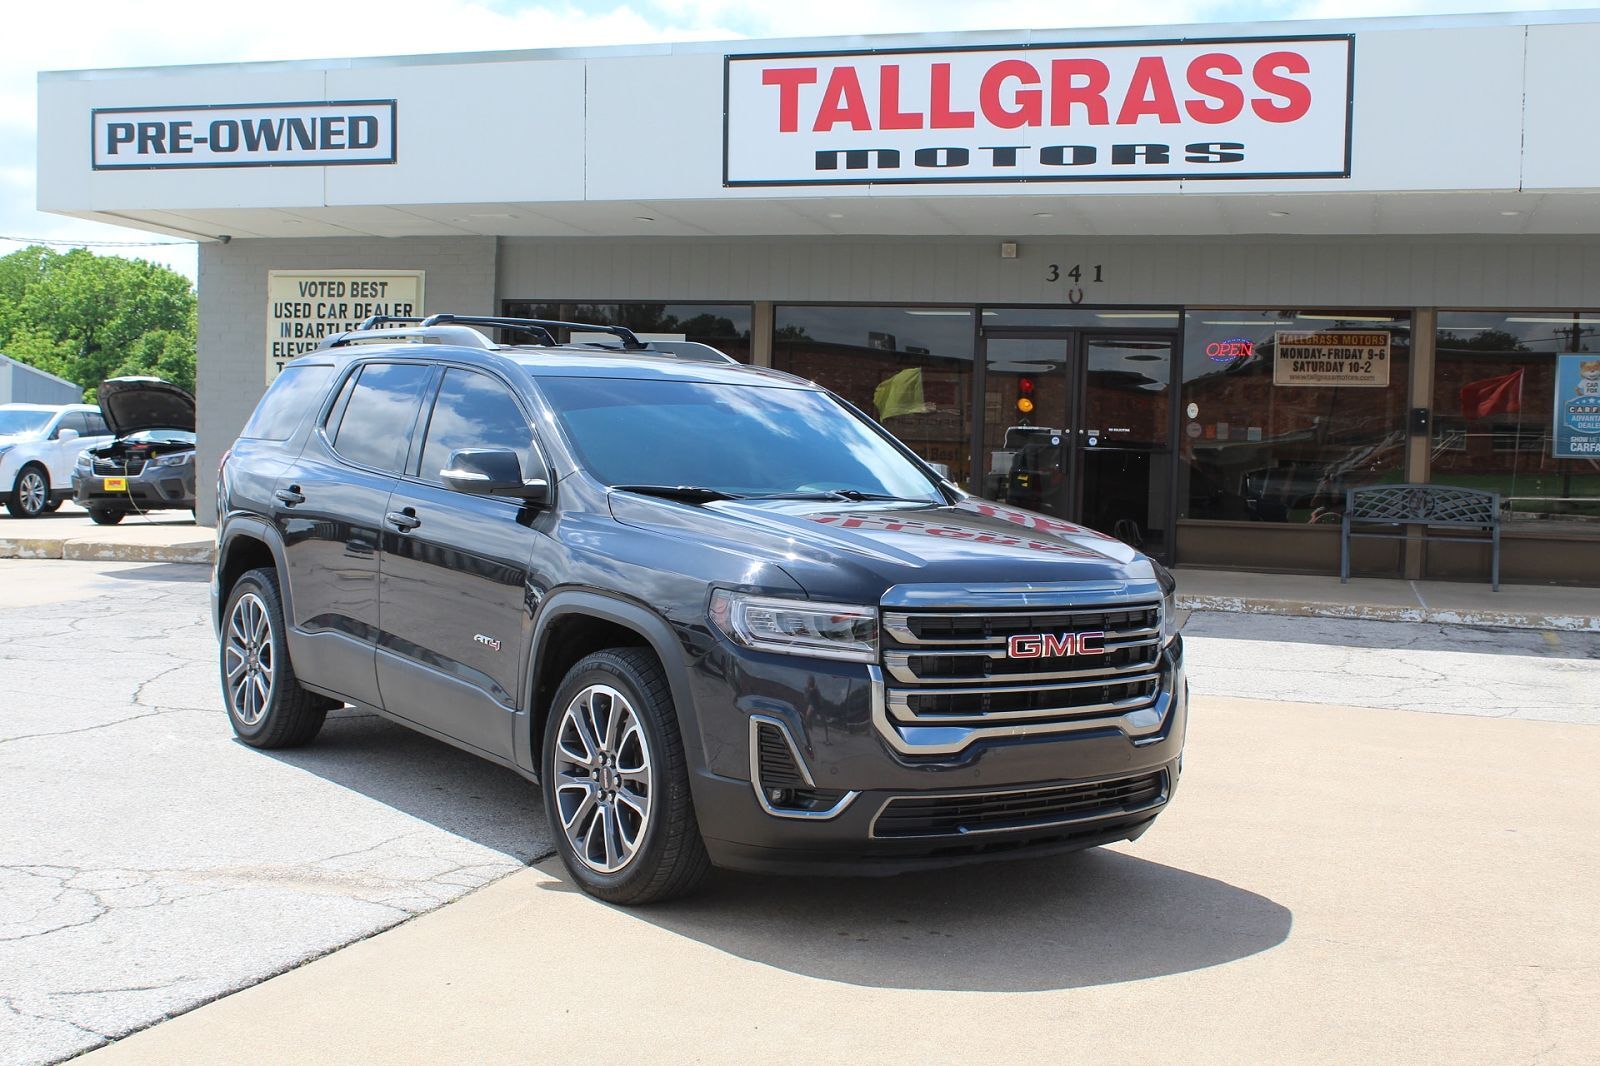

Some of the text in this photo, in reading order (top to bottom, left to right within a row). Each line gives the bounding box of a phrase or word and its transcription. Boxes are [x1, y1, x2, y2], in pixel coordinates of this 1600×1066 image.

[761, 50, 1312, 133] TALLGRASS
[106, 115, 379, 155] PRE-OWNED
[815, 142, 1246, 171] MOTORS
[299, 281, 388, 298] VOTED BEST
[274, 302, 413, 319] USED CAR DEALER
[280, 322, 292, 338] IN
[1282, 334, 1385, 346] TALLGRASS MOTORS
[1206, 342, 1254, 357] OPEN
[1280, 347, 1386, 361] MONDAY-FRIDAY 9-6
[1292, 360, 1372, 373] SATURDAY 10-2
[473, 633, 502, 652] AT4
[1008, 631, 1105, 659] GMC
